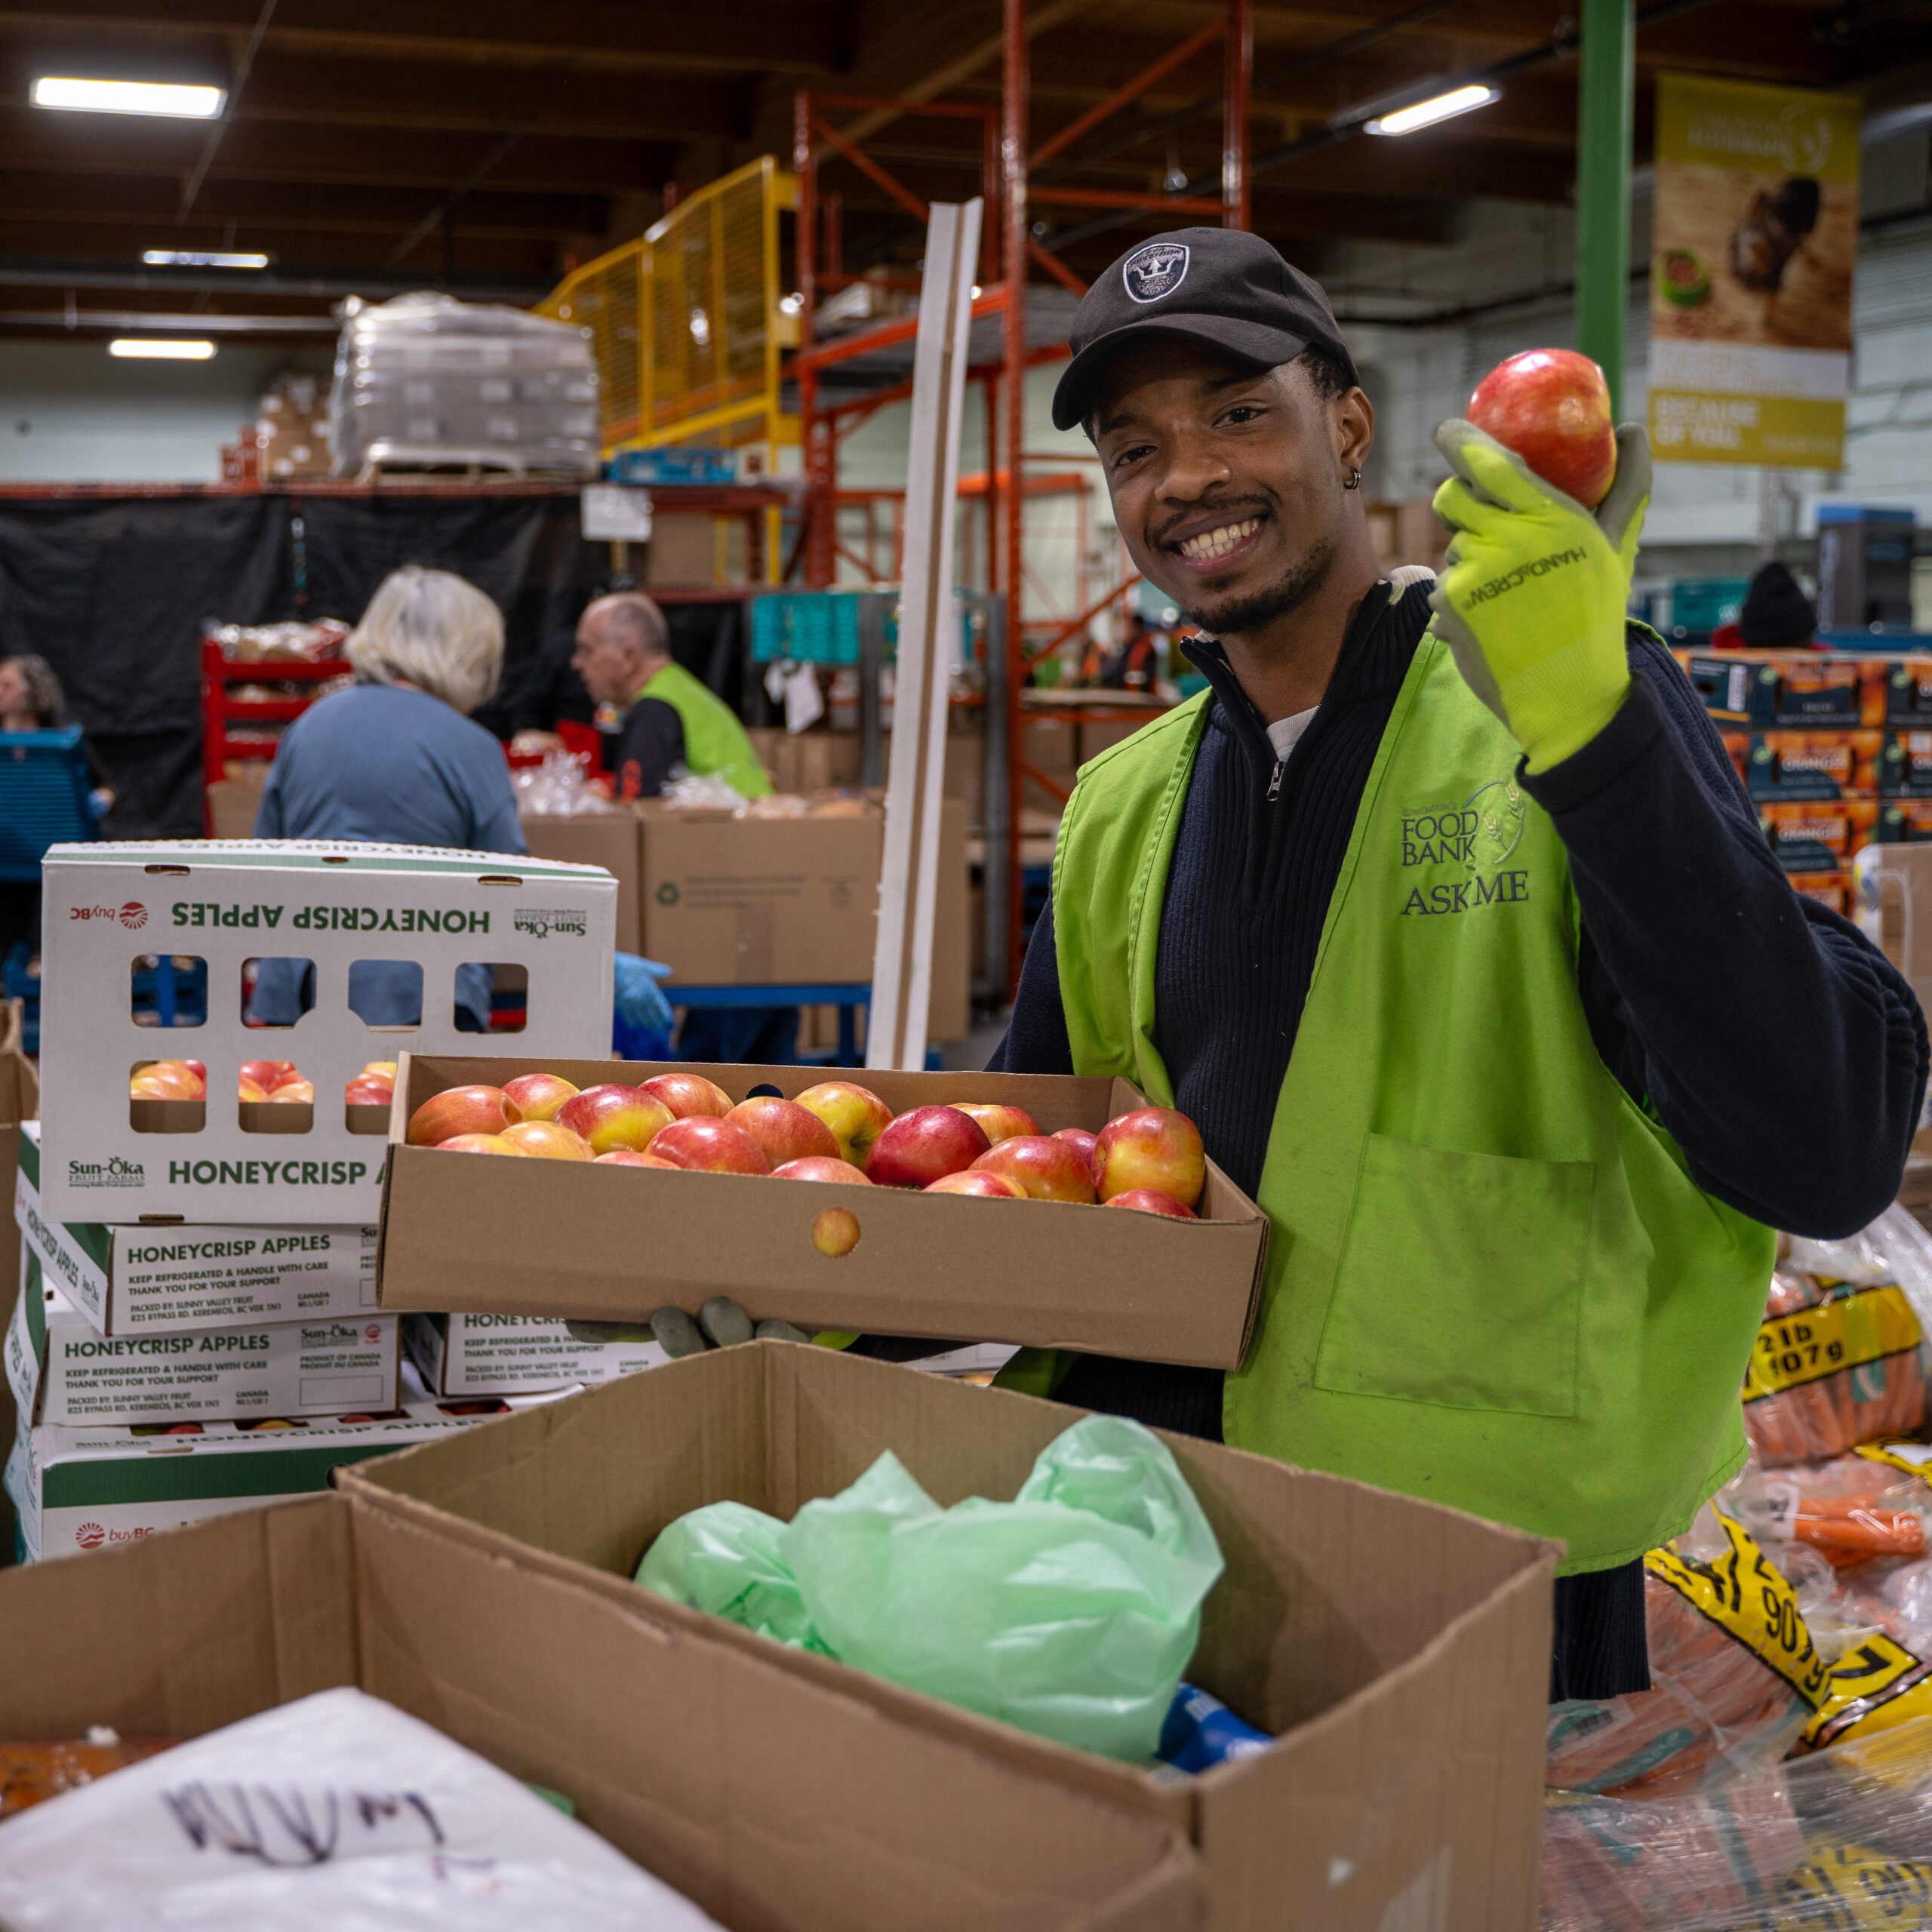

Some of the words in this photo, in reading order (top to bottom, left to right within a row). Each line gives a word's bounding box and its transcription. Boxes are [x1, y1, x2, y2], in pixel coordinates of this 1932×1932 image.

[1401, 810, 1478, 841] FOOD
[1401, 835, 1476, 866] BANK
[1401, 881, 1472, 915] ASK
[1473, 870, 1529, 906] ME
[70, 906, 115, 921] buyBC
[172, 902, 284, 928] APPLES
[293, 906, 490, 934] HONEYCRISP
[169, 1161, 367, 1185] HONEYCRISP
[128, 1239, 256, 1263] HONEYCRISP
[262, 1234, 331, 1254] APPLES
[129, 1274, 152, 1284] KEEP
[155, 1269, 223, 1282] REFRIGERATED
[226, 1268, 233, 1277] &
[237, 1266, 274, 1276] HANDLE
[277, 1263, 302, 1274] WITH
[305, 1262, 328, 1272] CARE
[129, 1285, 162, 1295] THANK
[165, 1284, 186, 1293] YOU
[189, 1282, 207, 1291] FOR
[211, 1280, 235, 1290] YOUR
[239, 1277, 281, 1287] SUPPORT
[131, 1303, 161, 1312] PACKED
[176, 1300, 204, 1309] SUNNY
[206, 1297, 230, 1307] VALLEY
[233, 1296, 254, 1305] FRUIT
[297, 1291, 330, 1300] CANADA
[148, 1311, 176, 1321] BYPASS
[464, 1314, 565, 1328] HONEYC
[65, 1338, 193, 1358] HONEYCRISP
[199, 1334, 269, 1352] APPLES
[92, 1365, 160, 1376] REFRIGERATED
[174, 1363, 212, 1372] HANDLE
[215, 1362, 240, 1371] WITH
[243, 1361, 267, 1369] CARE
[66, 1380, 99, 1389] THANK
[102, 1378, 123, 1387] YOU
[126, 1377, 144, 1386] FOR
[147, 1376, 174, 1385] YOUR
[177, 1374, 219, 1383] SUPPORT
[68, 1396, 97, 1404] PACKED
[113, 1394, 141, 1402] SUNNY
[143, 1393, 168, 1401] VALLEY
[171, 1392, 191, 1400] FRUIT
[176, 1426, 372, 1444] HONEYCRISP
